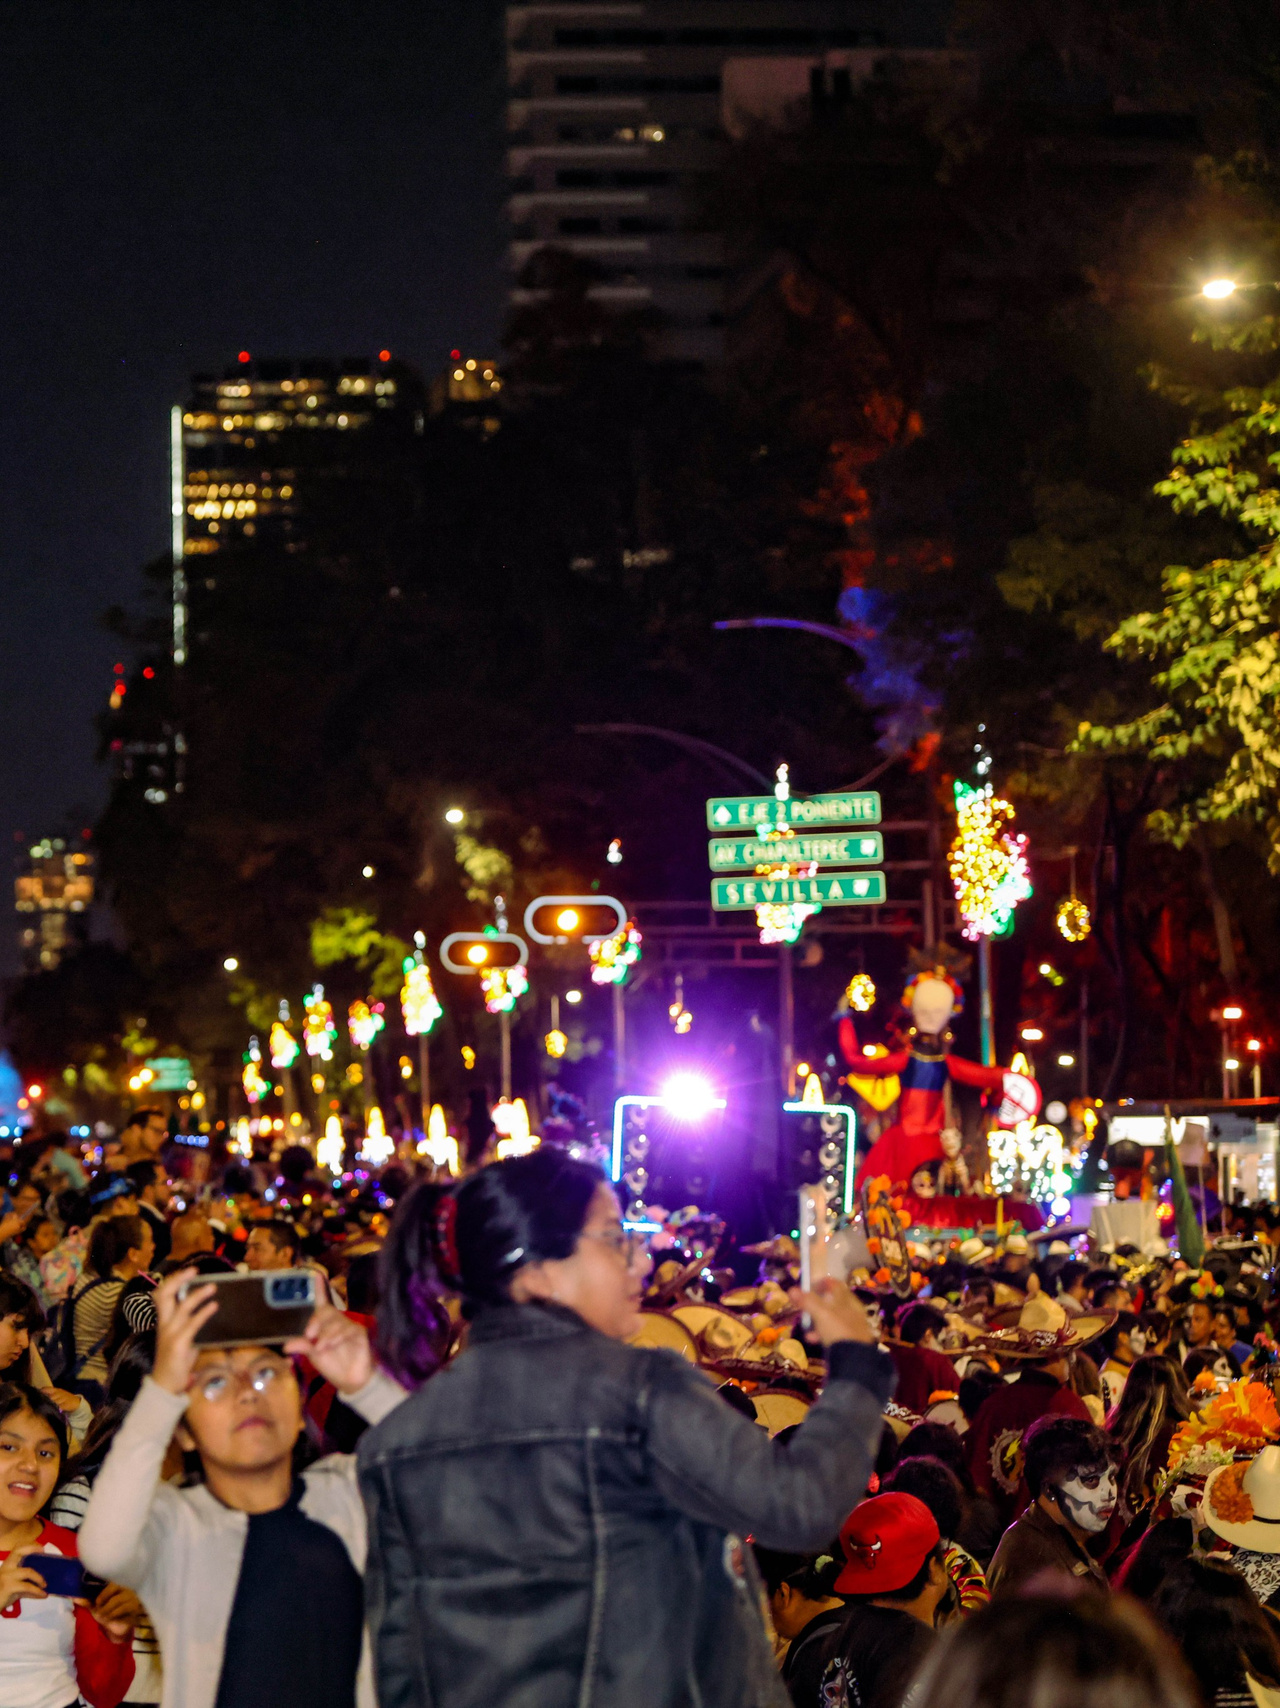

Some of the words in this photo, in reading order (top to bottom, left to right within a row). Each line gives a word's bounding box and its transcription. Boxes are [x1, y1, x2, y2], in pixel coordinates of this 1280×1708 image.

[738, 802, 769, 824] EJE
[775, 802, 787, 822] 2
[791, 798, 874, 821] PONENTE
[743, 839, 850, 864] CHAPULTEPEC
[726, 880, 844, 904] SEVILLA
